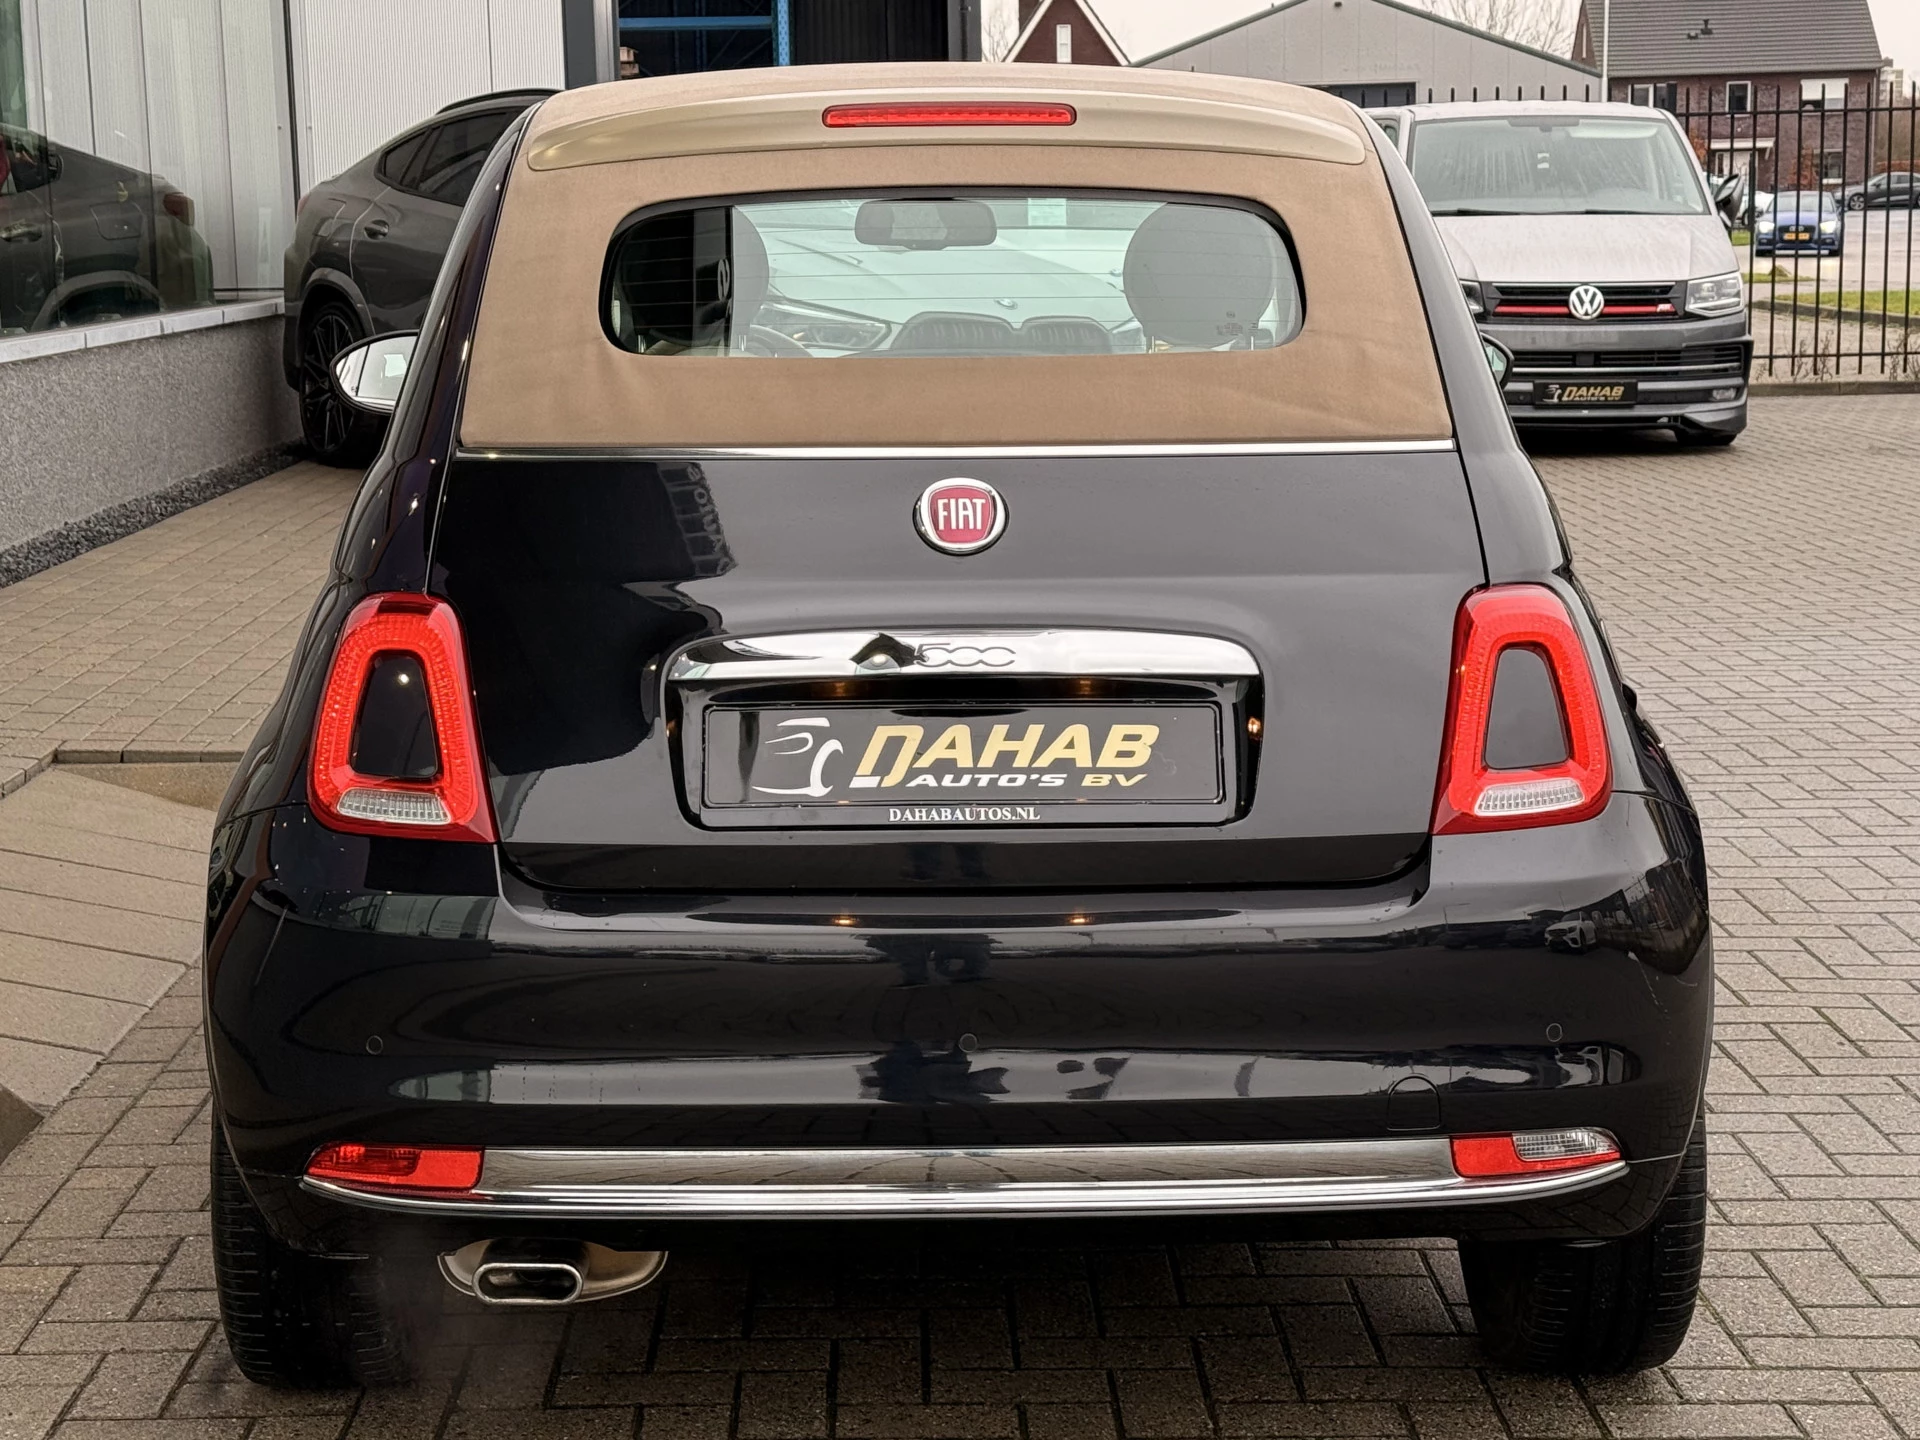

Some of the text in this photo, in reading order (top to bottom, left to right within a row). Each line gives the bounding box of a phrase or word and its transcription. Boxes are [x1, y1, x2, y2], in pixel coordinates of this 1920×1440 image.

[1562, 386, 1625, 401] DAHAB
[937, 498, 986, 530] FIAT
[915, 643, 1016, 667] 500
[849, 724, 1160, 788] DAHAB
[905, 773, 1148, 787] AUTO'S BV
[888, 807, 1040, 822] DAHABAUTOS.NL
